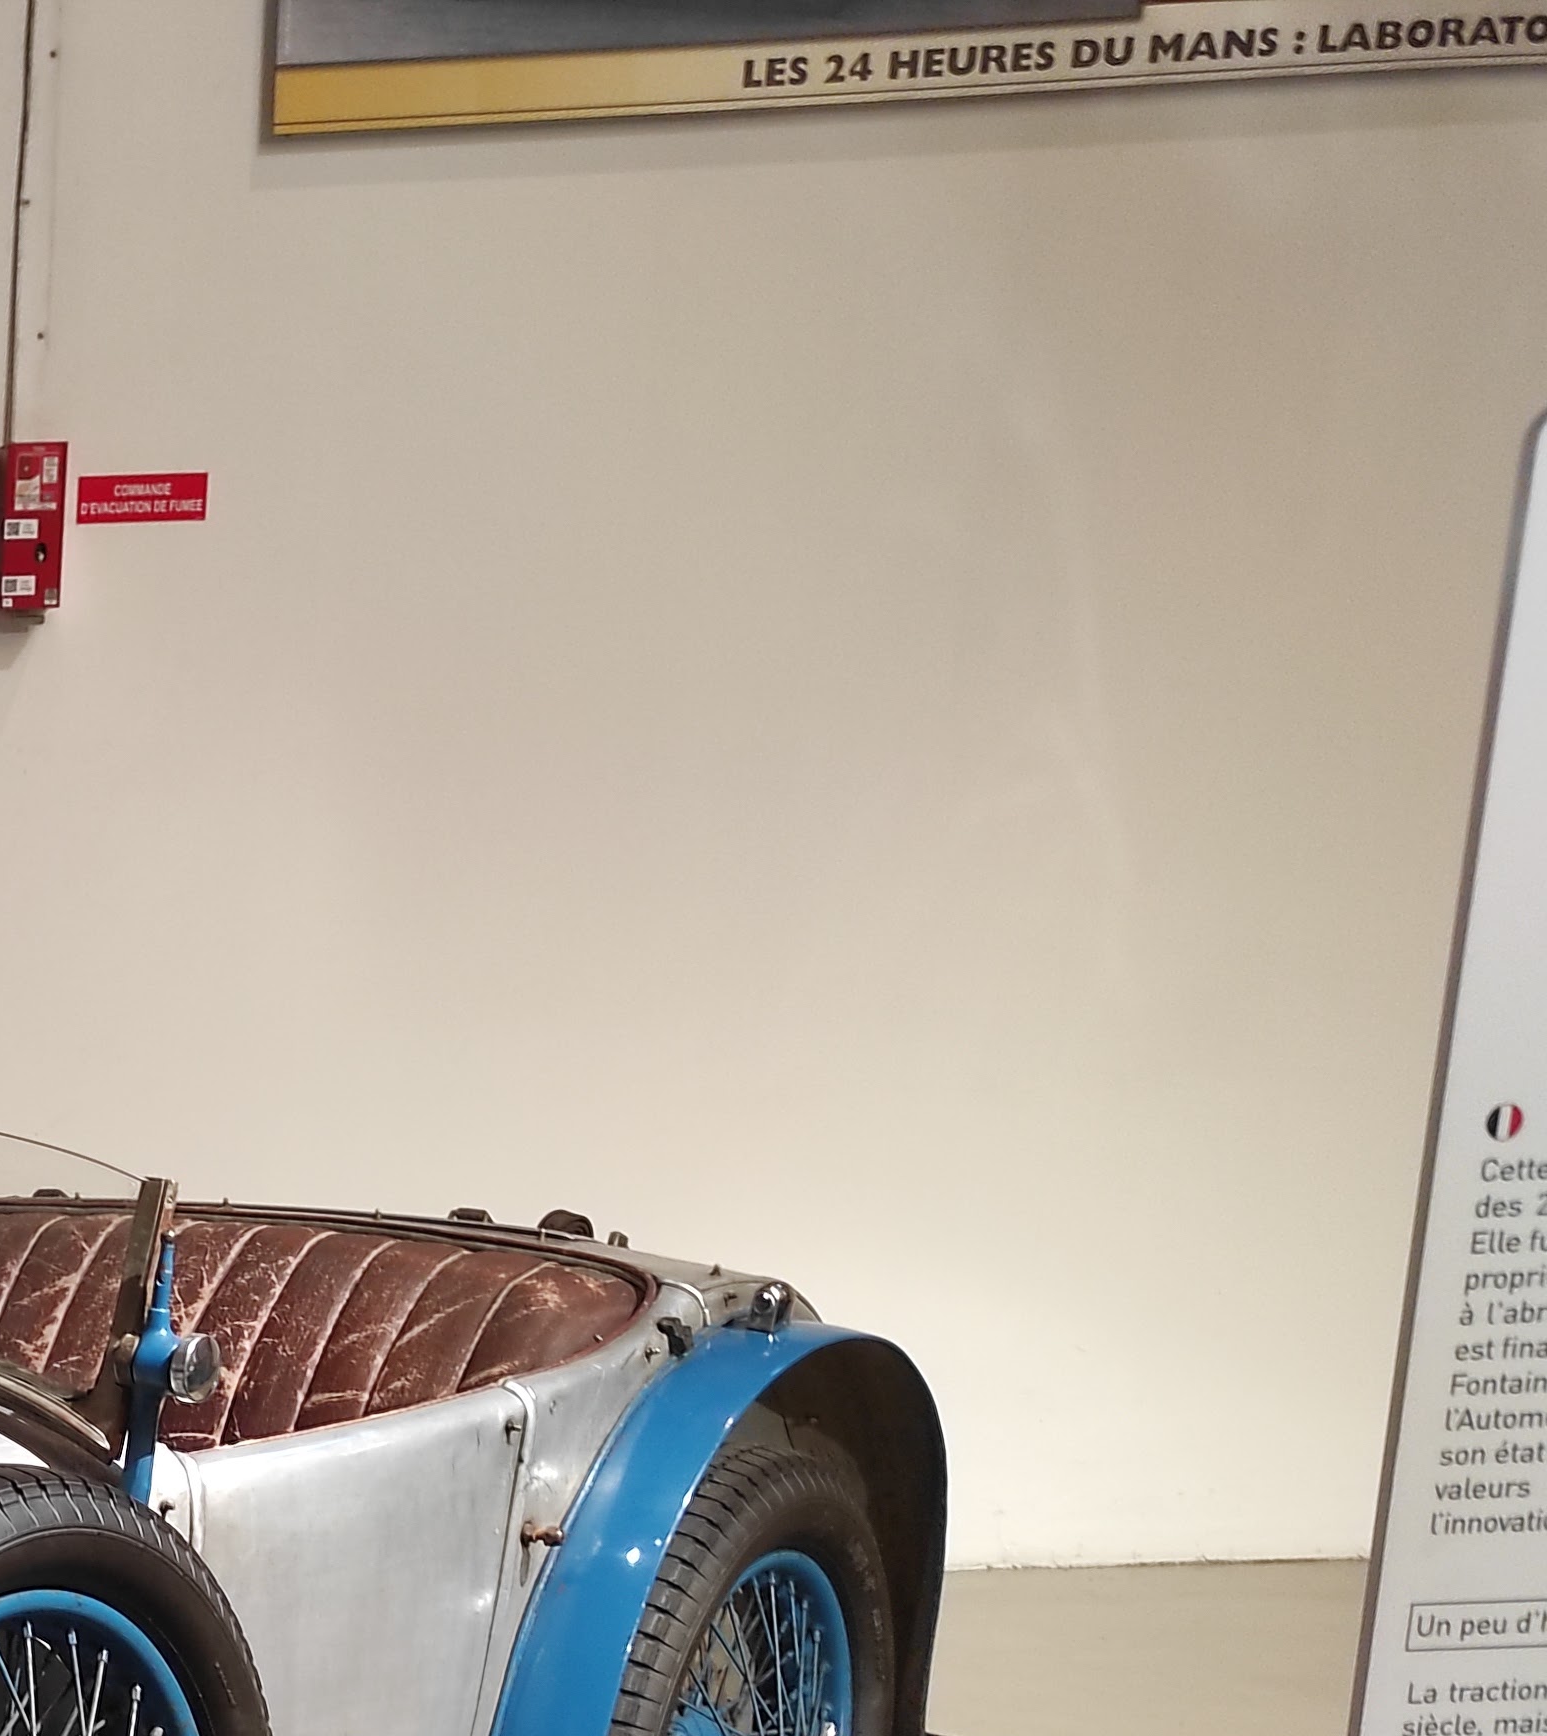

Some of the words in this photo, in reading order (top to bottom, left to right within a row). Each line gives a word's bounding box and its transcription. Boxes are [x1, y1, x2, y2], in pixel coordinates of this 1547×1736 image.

[743, 56, 808, 88] LES
[824, 52, 873, 84] 24
[888, 41, 1055, 80] HEURES
[1070, 36, 1135, 68] DU
[1148, 28, 1278, 64] MANS
[1317, 15, 1547, 53] LABORATO
[114, 483, 172, 497] COMMANDE
[154, 500, 167, 513] DE
[1481, 1158, 1547, 1183] Cette
[1474, 1195, 1522, 1219] des
[1470, 1230, 1521, 1256] Elle
[1464, 1266, 1547, 1296] propri
[1459, 1303, 1474, 1326] à
[1455, 1338, 1494, 1362] est
[1502, 1336, 1547, 1360] fina
[1450, 1371, 1547, 1398] Fontain
[1444, 1407, 1547, 1433] l'Autom
[1439, 1447, 1486, 1467] son
[1494, 1441, 1545, 1465] état
[1434, 1477, 1531, 1502] valeurs
[1417, 1614, 1451, 1638] Un
[1460, 1617, 1507, 1642] peu
[1407, 1682, 1437, 1705] La
[1449, 1678, 1547, 1704] traction
